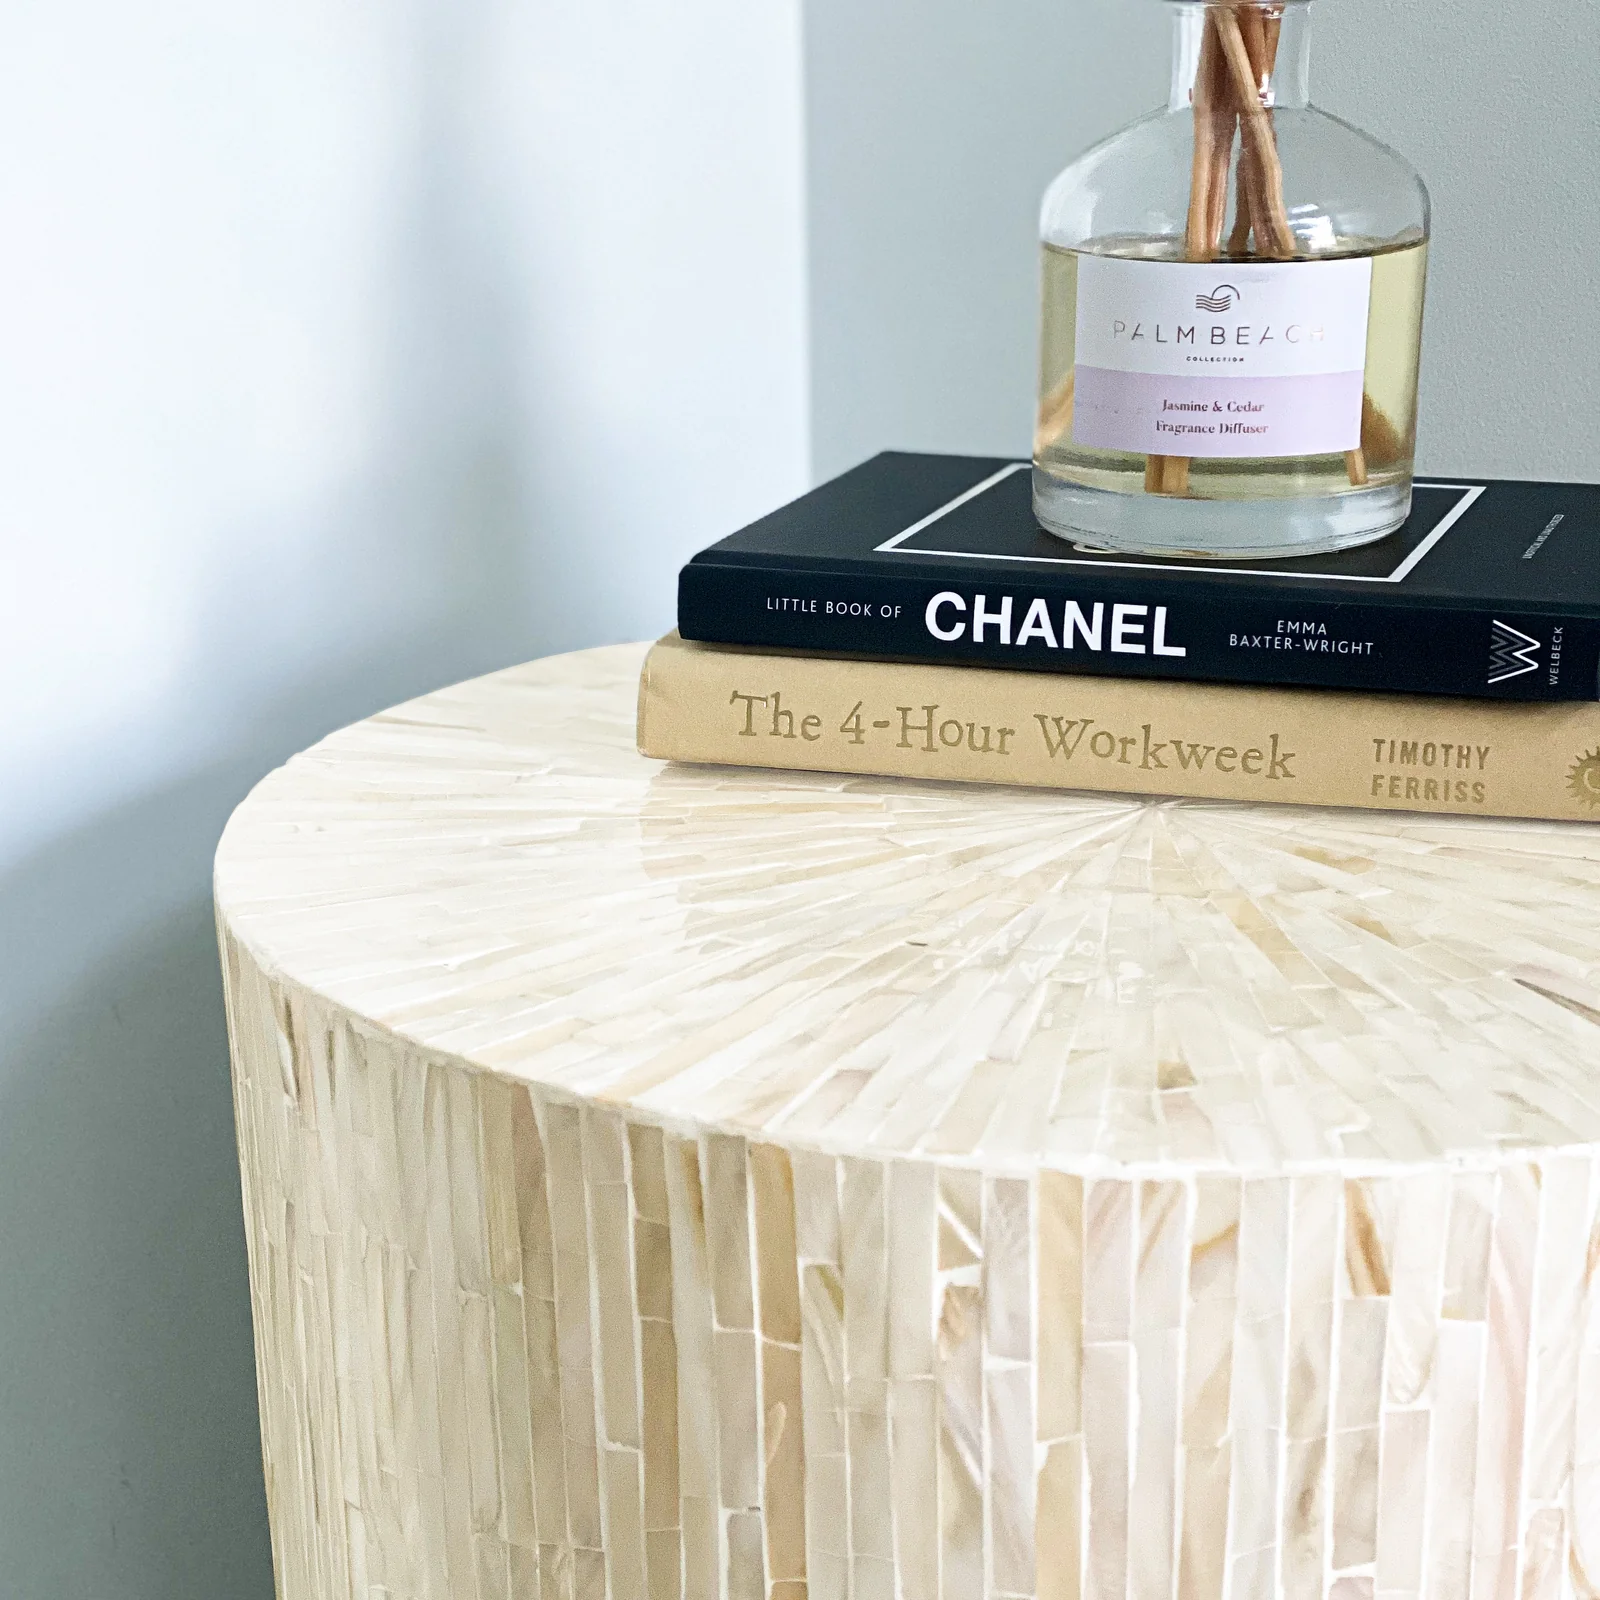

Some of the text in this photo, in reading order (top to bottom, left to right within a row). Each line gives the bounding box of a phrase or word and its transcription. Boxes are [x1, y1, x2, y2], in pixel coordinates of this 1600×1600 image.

[1113, 320, 1325, 345] PALM BEACH
[1185, 355, 1245, 363] COLLECTION
[1162, 399, 1265, 412] Jasmine & Cedar
[1156, 420, 1269, 436] Fragrance Diffuser
[767, 591, 1187, 657] LITTLE BOOK OF CHANEL
[1276, 620, 1327, 635] EMMA
[1229, 634, 1374, 655] BAXTER-WRIGHT
[1549, 626, 1563, 685] WELBECK
[729, 690, 1296, 779] The 4-Hour Workweek
[1372, 738, 1490, 769] TIMOTHY
[1370, 774, 1485, 803] FERRISS
